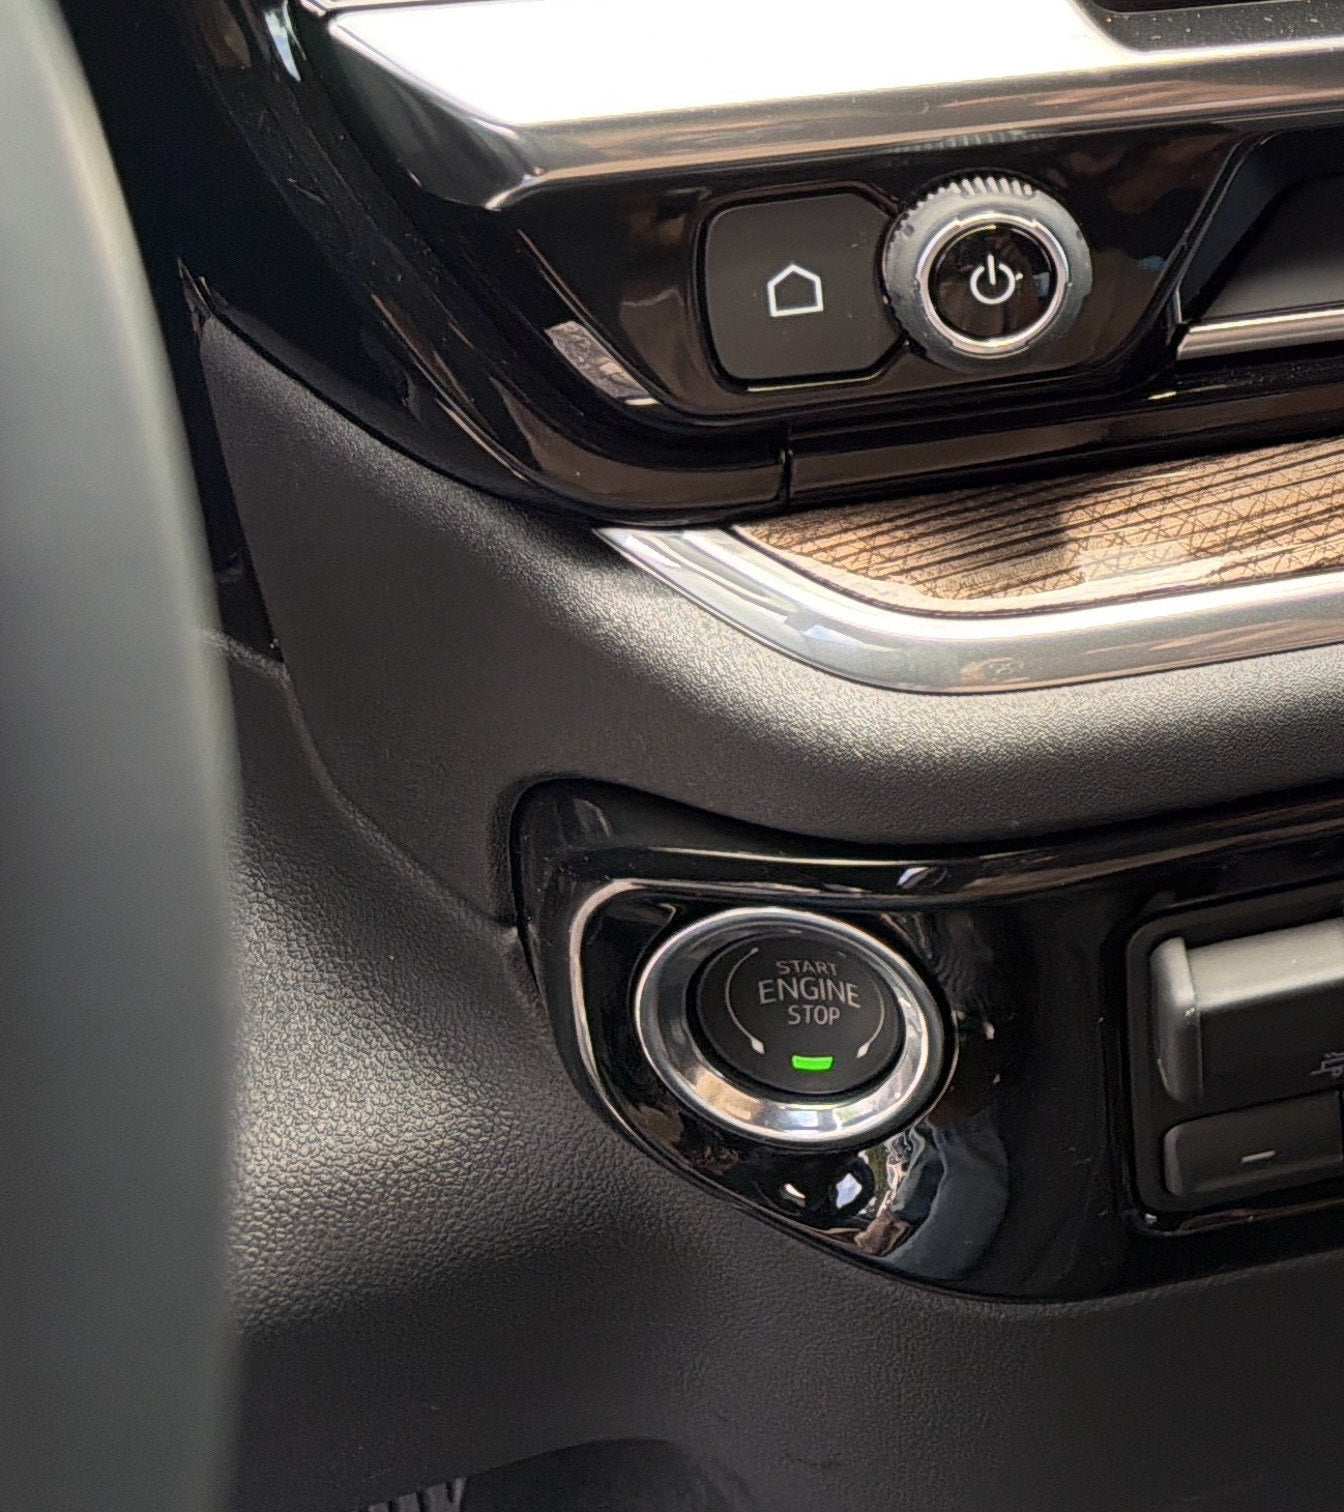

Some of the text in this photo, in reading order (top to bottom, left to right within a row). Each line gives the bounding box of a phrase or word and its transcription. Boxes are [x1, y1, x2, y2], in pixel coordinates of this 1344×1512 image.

[775, 960, 837, 976] START
[759, 977, 861, 1008] ENGINE
[787, 1004, 841, 1026] STOP
